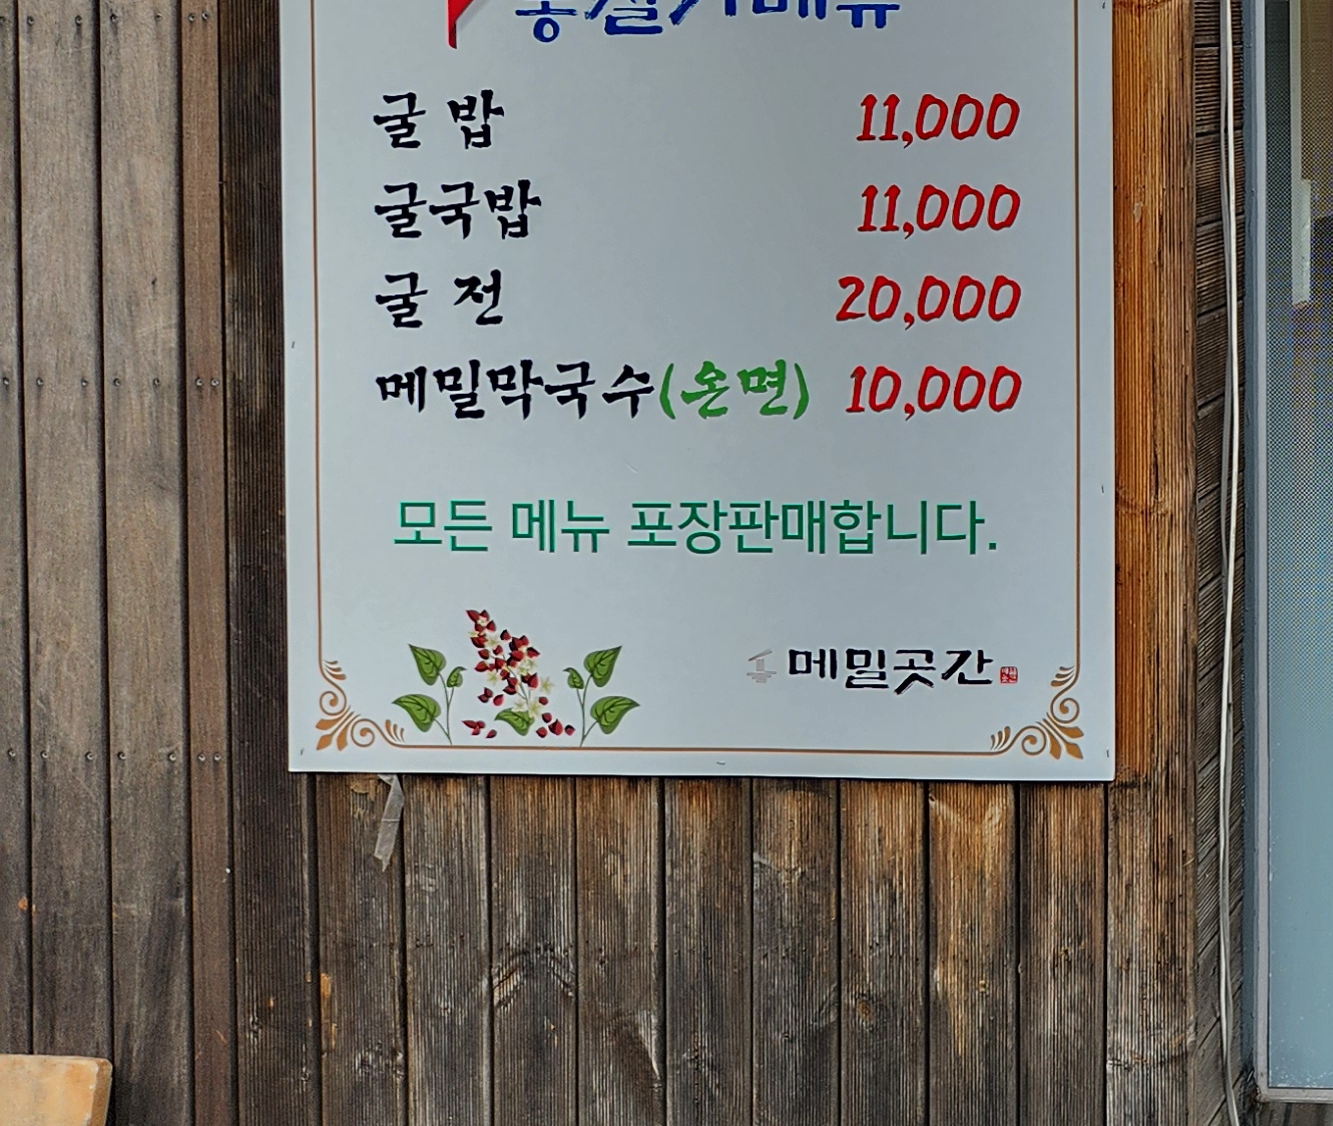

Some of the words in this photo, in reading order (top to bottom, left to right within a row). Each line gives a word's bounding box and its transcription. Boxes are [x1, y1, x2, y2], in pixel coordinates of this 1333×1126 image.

[374, 92, 426, 148] 굴
[447, 90, 504, 149] 밥
[856, 93, 1020, 149] 11,000
[375, 180, 541, 239] 굴국밥
[858, 184, 1020, 239] 11,000
[376, 272, 428, 328] 굴
[454, 269, 503, 325] 전
[836, 275, 1021, 330] 20,000
[376, 359, 809, 420] 메밀막국수(온면)
[846, 366, 1022, 421] 10,000
[395, 501, 492, 551] 모든
[512, 500, 609, 553] 메뉴
[628, 500, 996, 555] 포장판매합니다.
[789, 649, 993, 695] 메밀곳간
